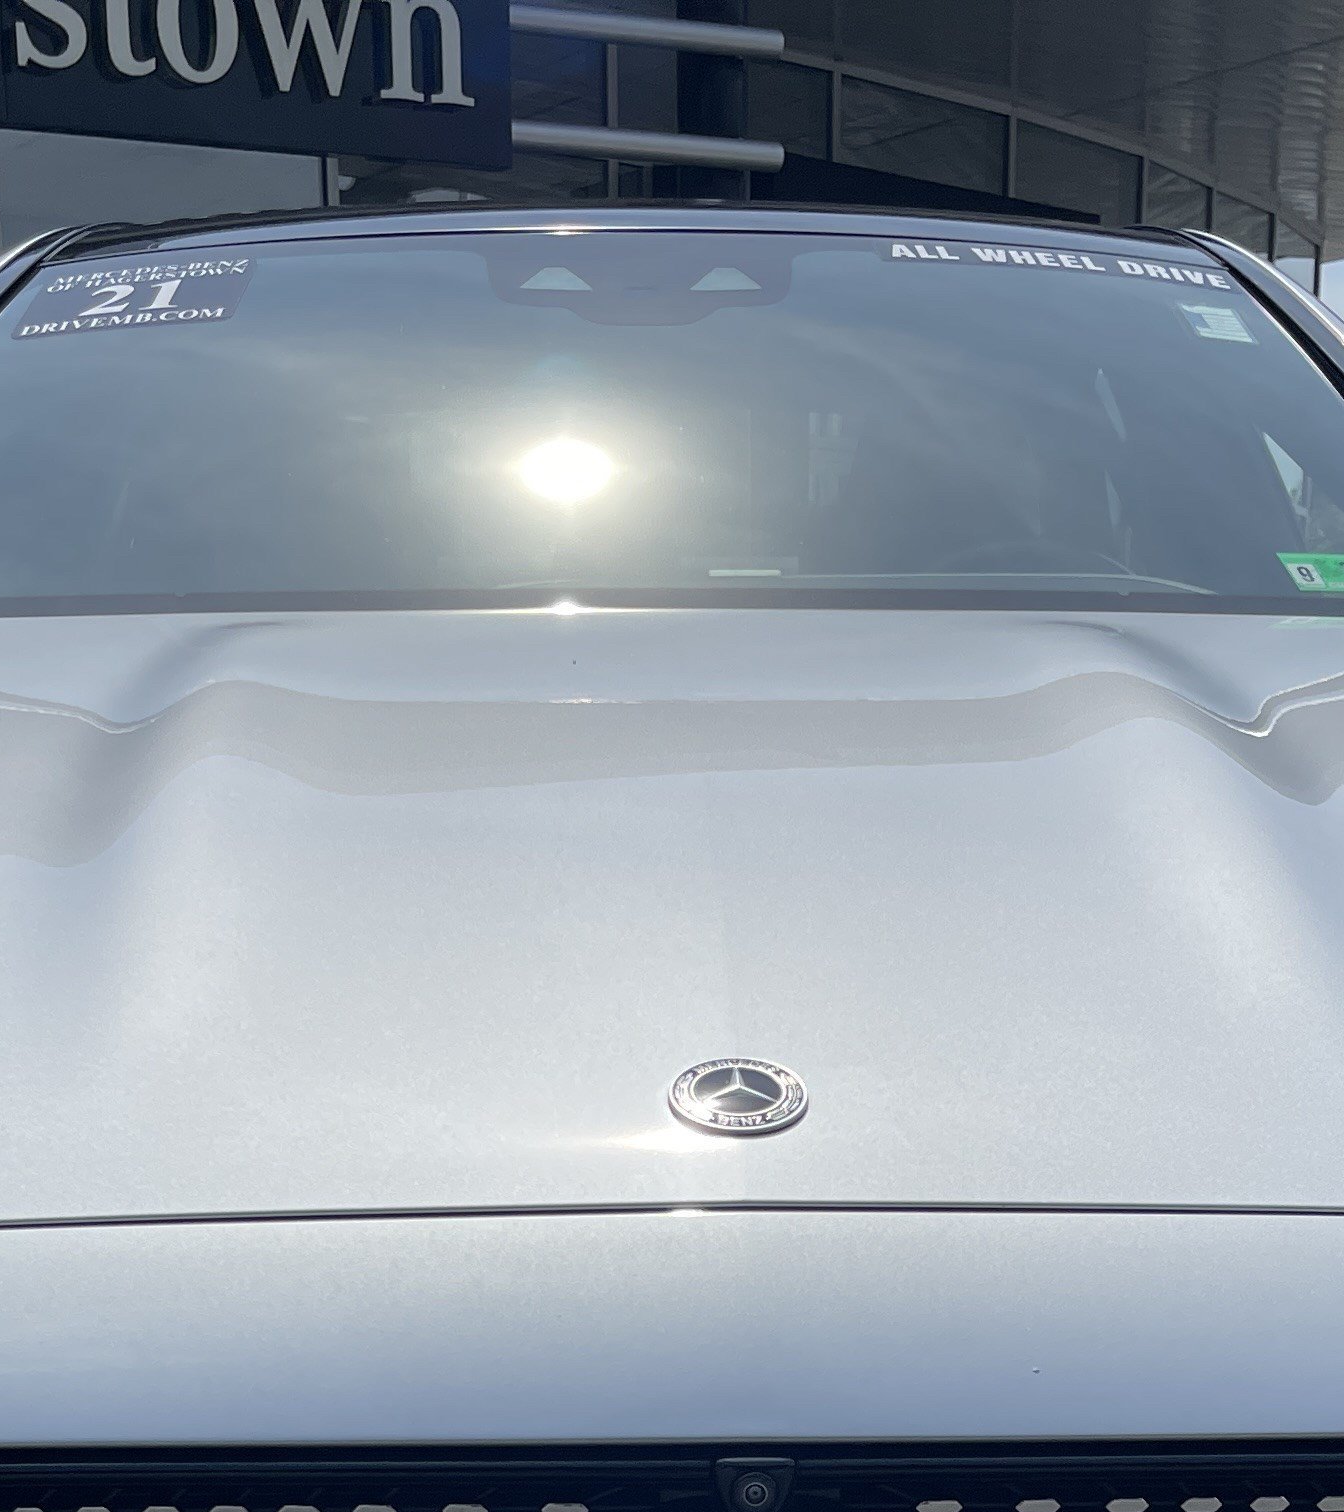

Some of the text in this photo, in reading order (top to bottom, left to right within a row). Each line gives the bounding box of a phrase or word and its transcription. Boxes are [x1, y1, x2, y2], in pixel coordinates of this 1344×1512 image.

[891, 243, 1232, 290] ALL WHEEL DRIVE
[77, 279, 182, 317] 21
[20, 307, 226, 337] DRIVEMB.COM
[1296, 566, 1315, 583] 9
